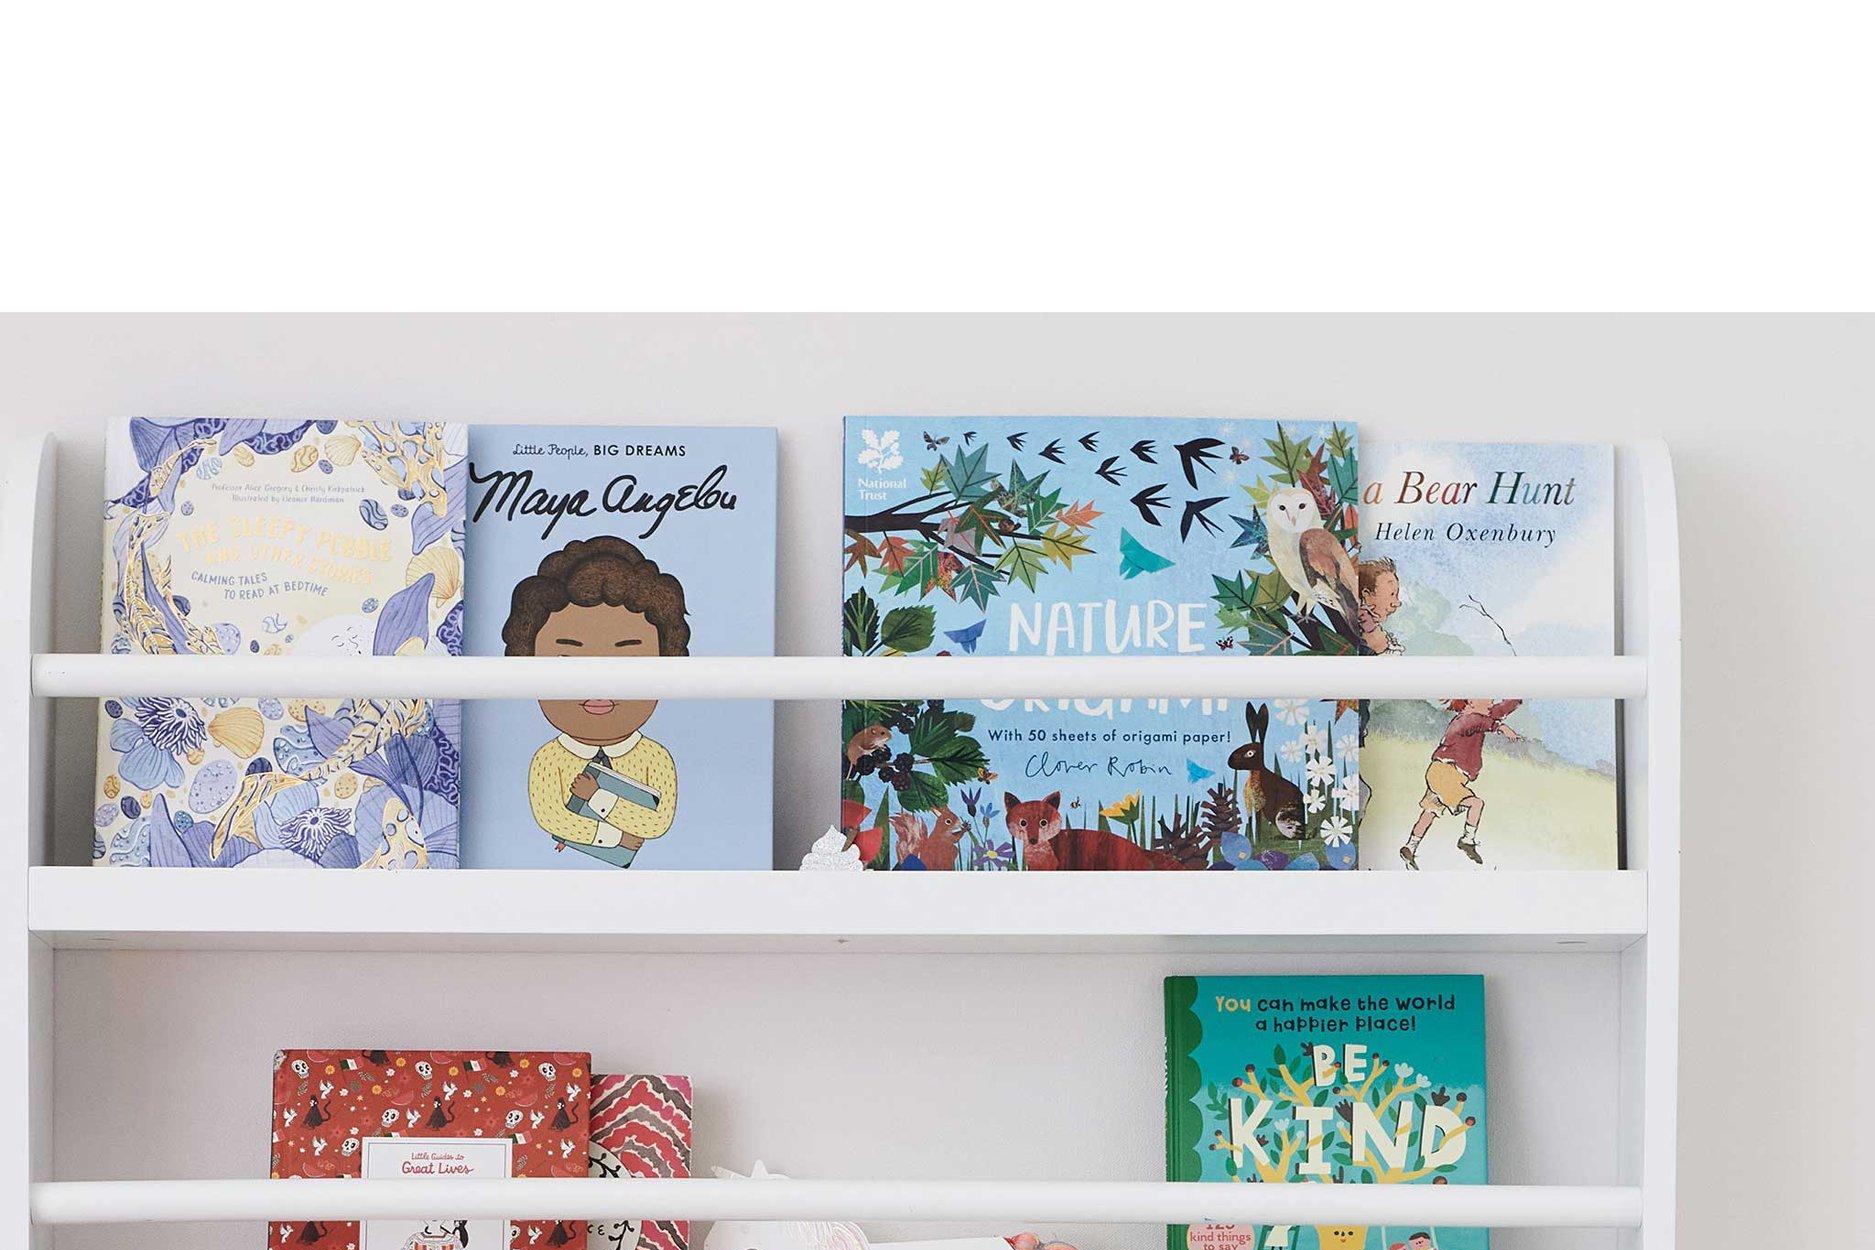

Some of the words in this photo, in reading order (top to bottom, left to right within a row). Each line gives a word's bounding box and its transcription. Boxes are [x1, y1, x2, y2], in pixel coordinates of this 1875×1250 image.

[512, 444, 545, 456] Little
[548, 443, 589, 460] People,
[594, 444, 619, 456] BIG
[625, 445, 686, 457] DREAMS
[858, 478, 907, 489] National
[1363, 480, 1383, 505] a
[1394, 471, 1478, 505] Bear
[1485, 471, 1576, 506] Hunt
[469, 462, 597, 540] Maya
[601, 464, 738, 540] Angelou
[857, 489, 887, 500] Trust
[176, 521, 220, 552] THE
[229, 515, 312, 547] SLEEPY
[317, 529, 393, 562] PEBBLE
[1375, 522, 1435, 542] Helen
[1446, 522, 1557, 548] Oxenbury
[191, 570, 235, 586] CALMING
[238, 572, 268, 585] TALES
[224, 589, 236, 600] TO
[239, 588, 264, 600] READ
[269, 584, 279, 596] AT
[284, 581, 329, 597] BEDTIME
[1008, 598, 1208, 656] NATURE
[988, 729, 1022, 743] With
[1028, 729, 1046, 743] 50
[1052, 729, 1097, 743] sheets
[1103, 729, 1117, 743] of
[1122, 730, 1177, 747] origami
[1183, 731, 1231, 746] paper!
[1025, 751, 1098, 778] Clover
[1107, 755, 1172, 778] Robin
[1215, 995, 1251, 1013] You
[1257, 997, 1294, 1012] can
[1300, 996, 1351, 1012] make
[1357, 995, 1389, 1011] the
[1395, 994, 1456, 1011] world
[1256, 1018, 1267, 1032] a
[1273, 1016, 1349, 1033] happier
[1355, 1015, 1417, 1033] place!
[1312, 1043, 1368, 1087] BE
[1228, 1097, 1467, 1175] KIND
[411, 1152, 430, 1160] Little
[455, 1153, 466, 1161] to
[401, 1161, 435, 1175] Great
[438, 1162, 475, 1175] Lives
[1190, 1231, 1214, 1242] kind
[1217, 1231, 1251, 1246] things
